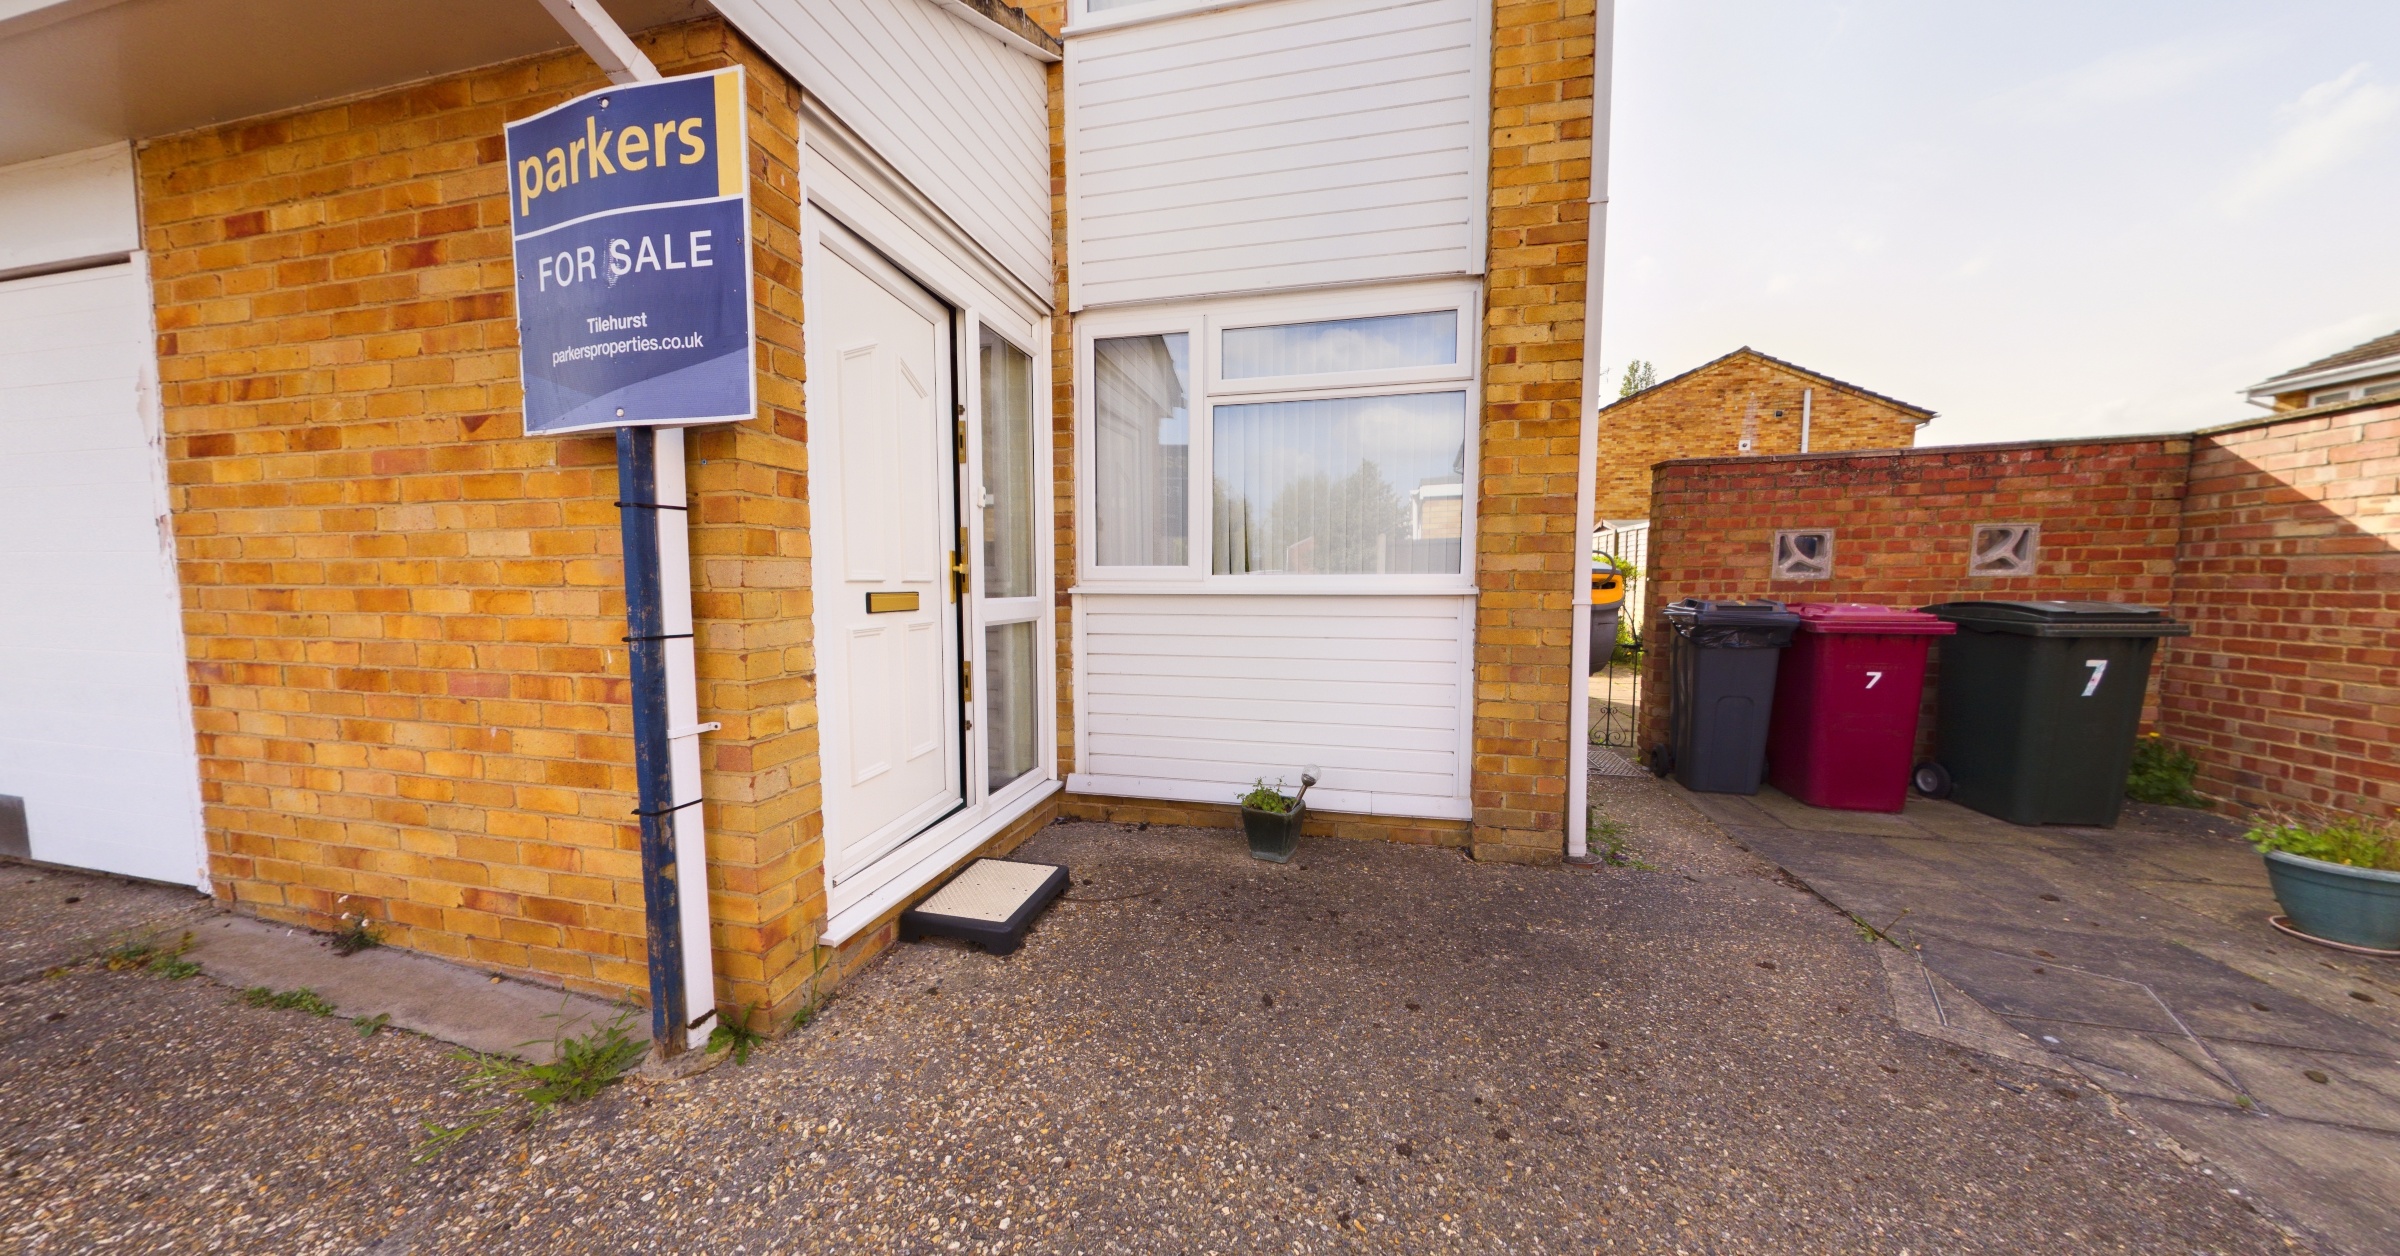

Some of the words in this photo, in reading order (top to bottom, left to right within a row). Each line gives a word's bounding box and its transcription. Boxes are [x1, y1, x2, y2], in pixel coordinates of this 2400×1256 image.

[517, 116, 706, 217] parkers
[538, 246, 597, 292] FOR
[610, 230, 714, 276] SALE
[586, 312, 648, 334] Tilehurst
[552, 331, 704, 367] parkersproperties.co.uk
[1865, 671, 1883, 689] 7
[2081, 659, 2108, 697] 7
